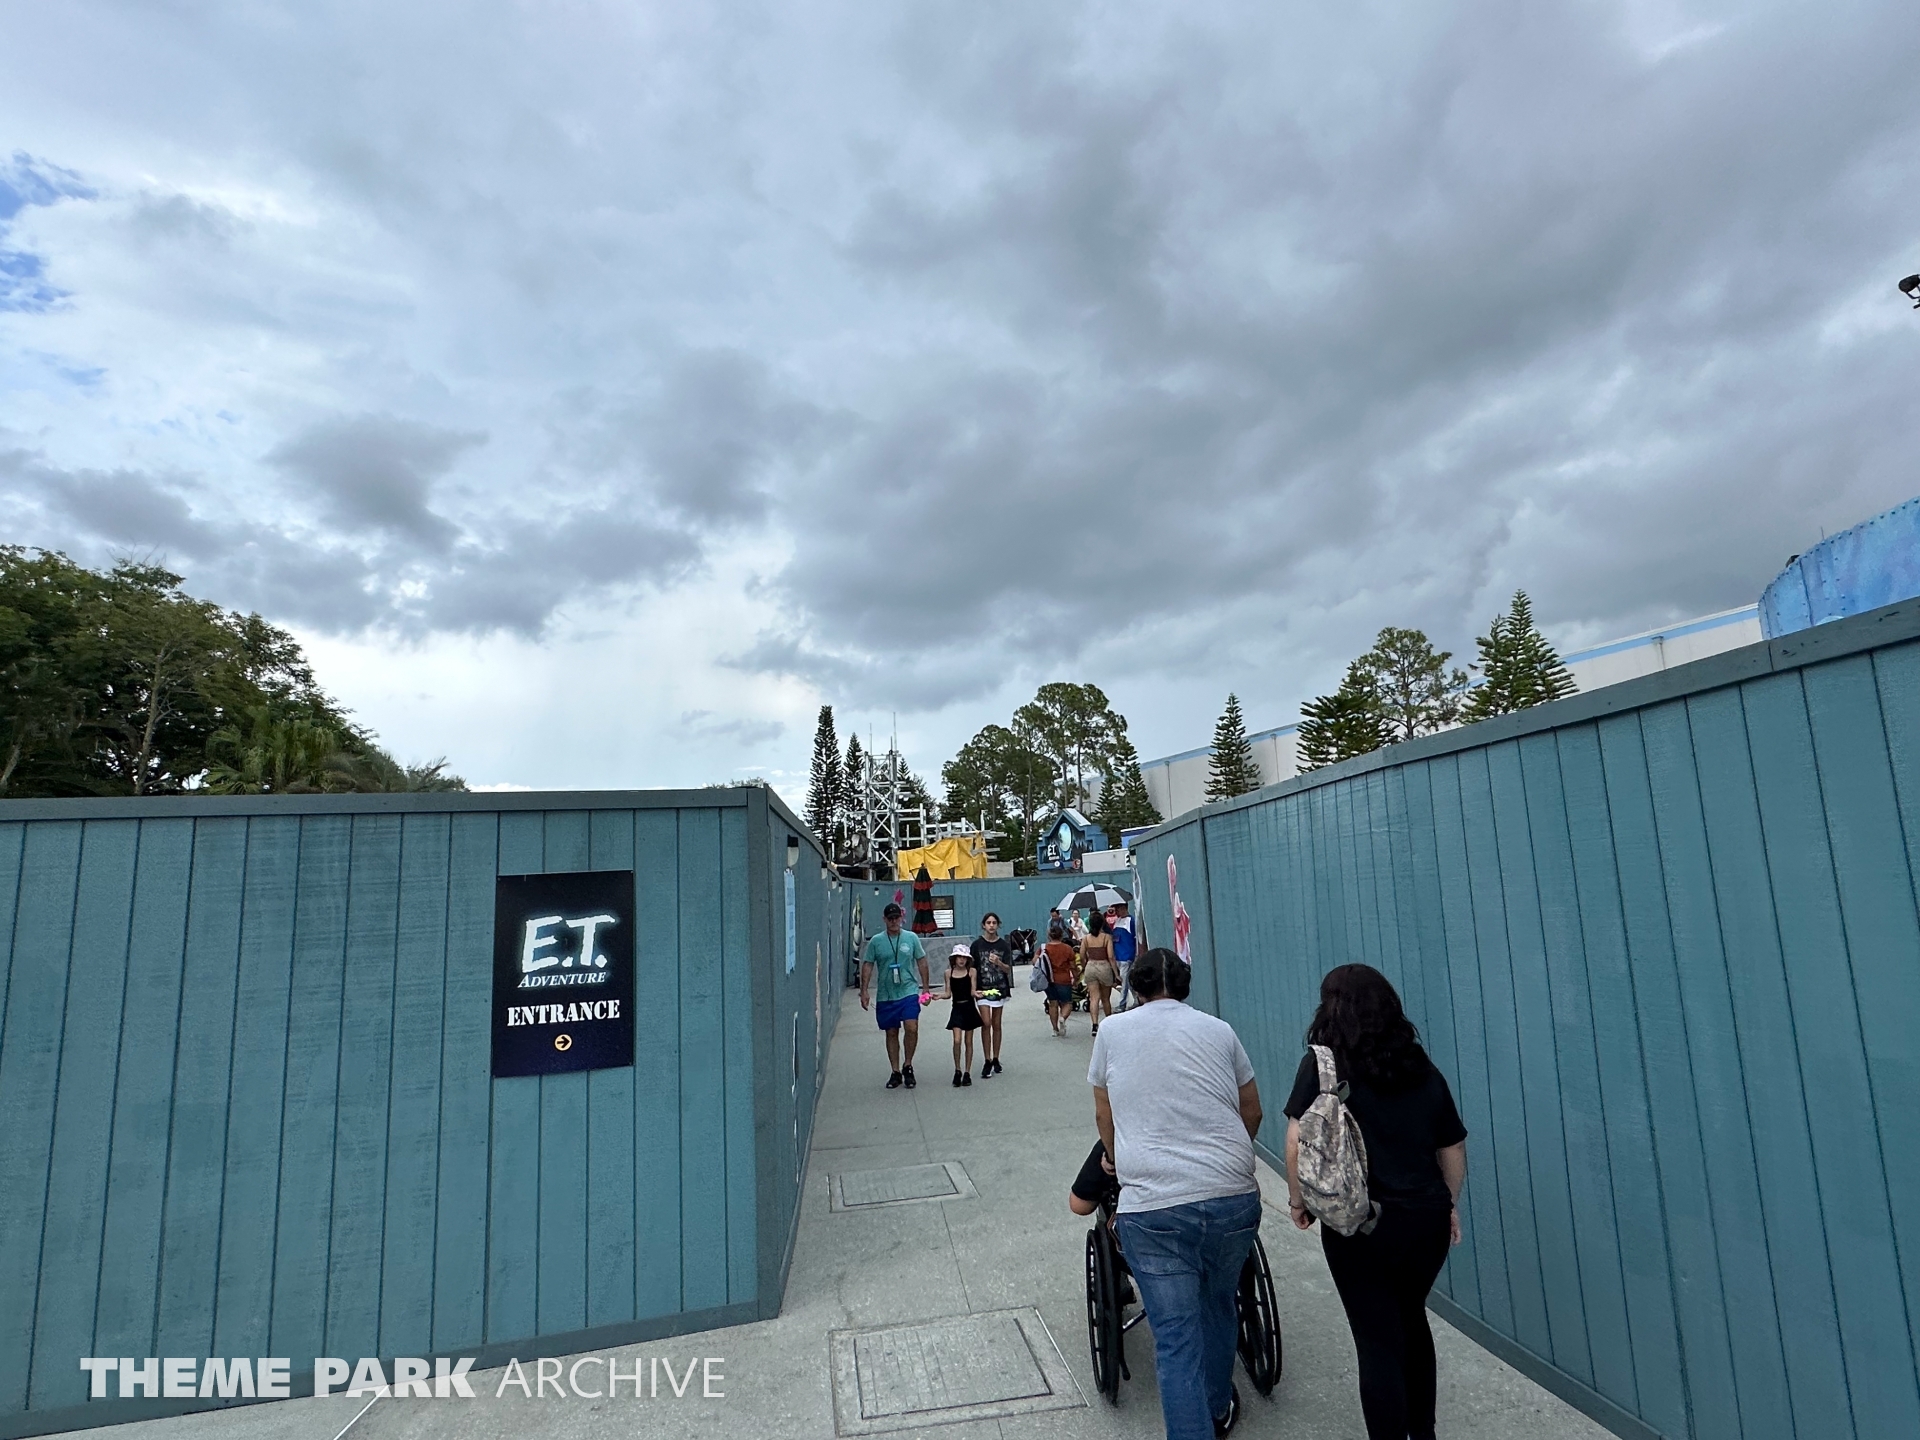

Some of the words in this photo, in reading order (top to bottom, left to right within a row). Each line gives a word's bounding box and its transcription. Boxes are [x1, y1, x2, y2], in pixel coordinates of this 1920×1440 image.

[522, 914, 616, 973] E.T.
[518, 972, 606, 988] ADVENTURE
[507, 1000, 620, 1026] ENTRANCE
